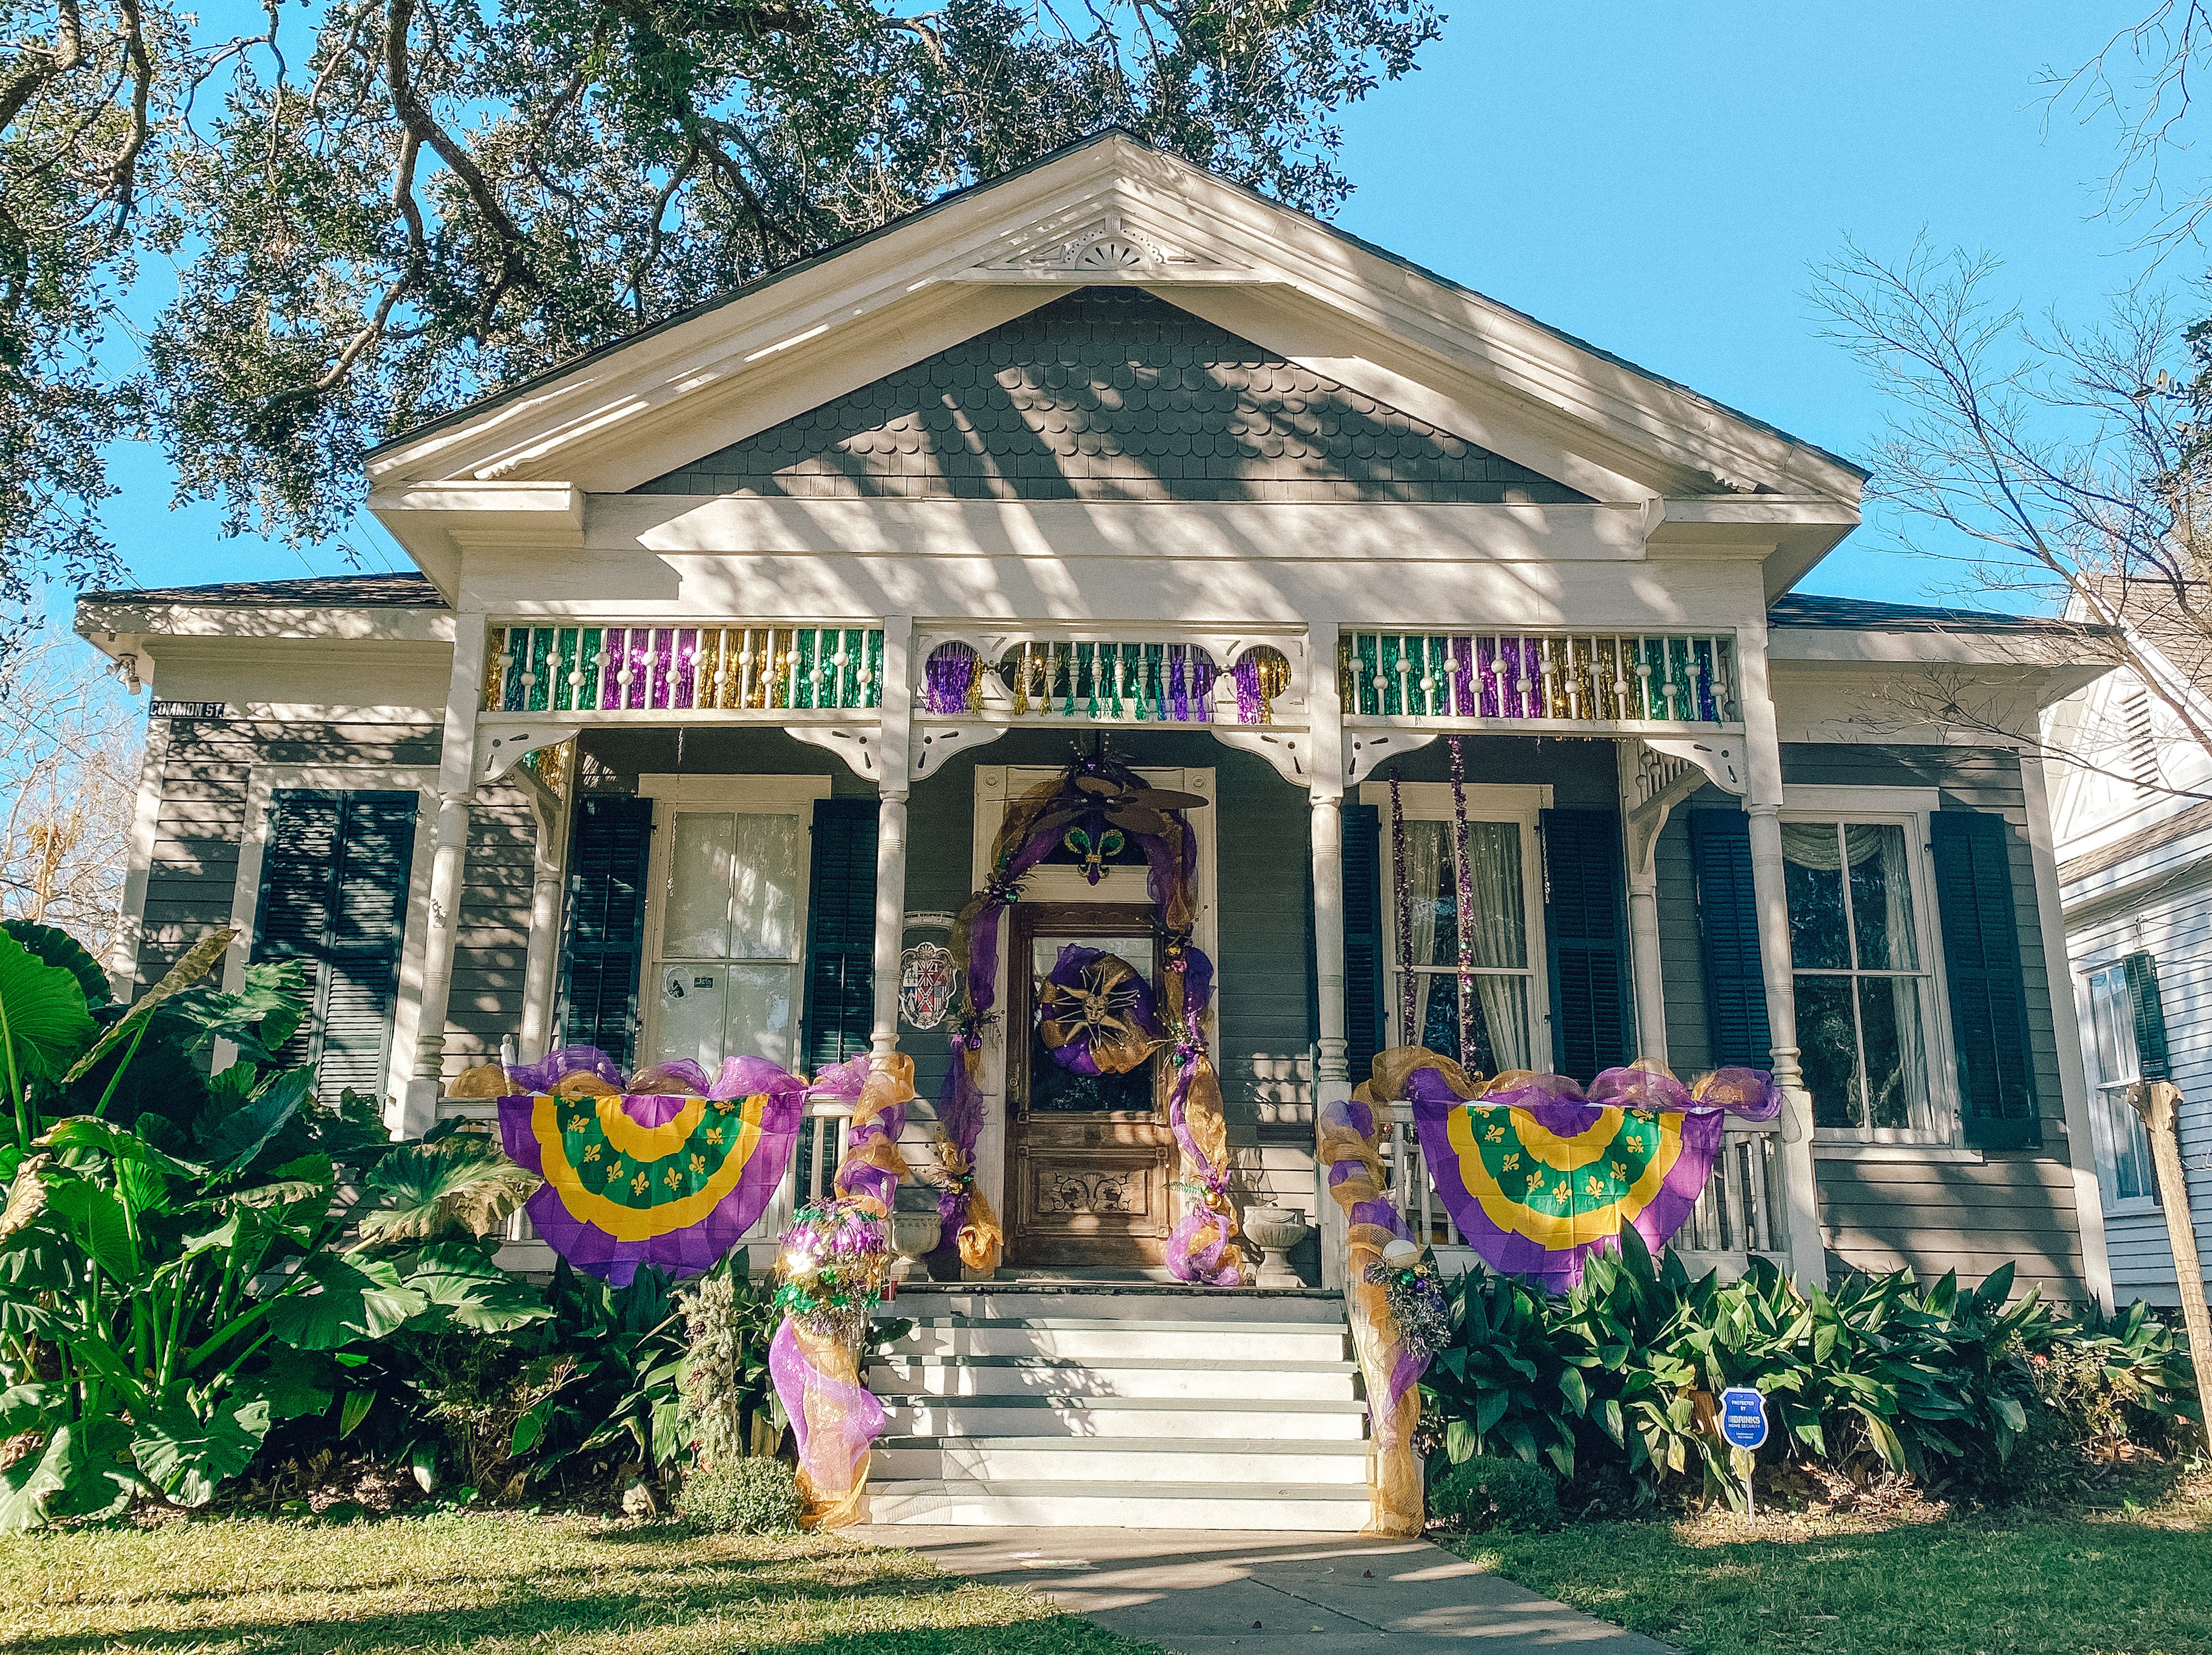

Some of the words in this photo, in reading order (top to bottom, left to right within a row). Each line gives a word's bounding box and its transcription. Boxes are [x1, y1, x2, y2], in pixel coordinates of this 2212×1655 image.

[150, 702, 204, 717] COMMON
[205, 704, 223, 718] ST.
[1733, 1415, 1761, 1424] BRINKS
